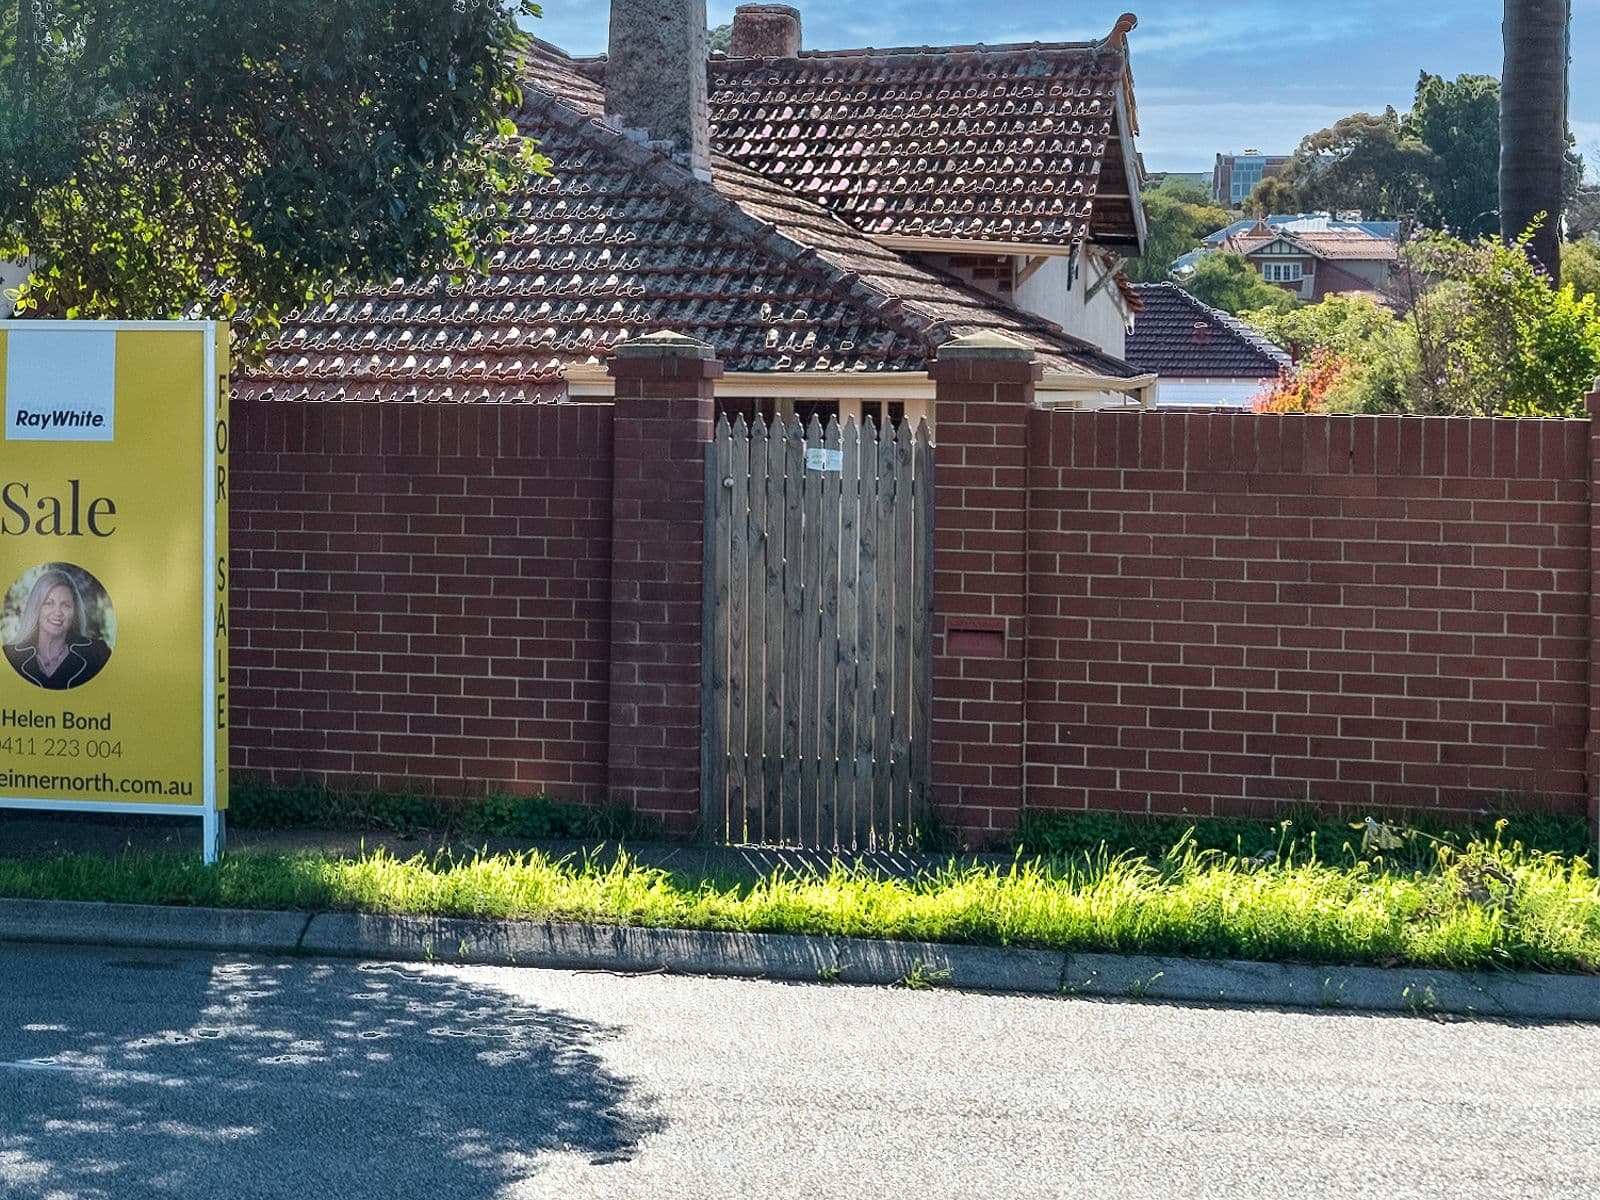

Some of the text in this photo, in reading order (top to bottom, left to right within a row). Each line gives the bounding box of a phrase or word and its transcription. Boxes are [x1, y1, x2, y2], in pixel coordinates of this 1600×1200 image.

[16, 410, 104, 430] RayWhite
[1, 479, 117, 537] Sale
[215, 374, 228, 730] FOR SALE
[2, 709, 111, 731] Helen Bond
[44, 738, 80, 758] 223
[86, 739, 123, 759] 004
